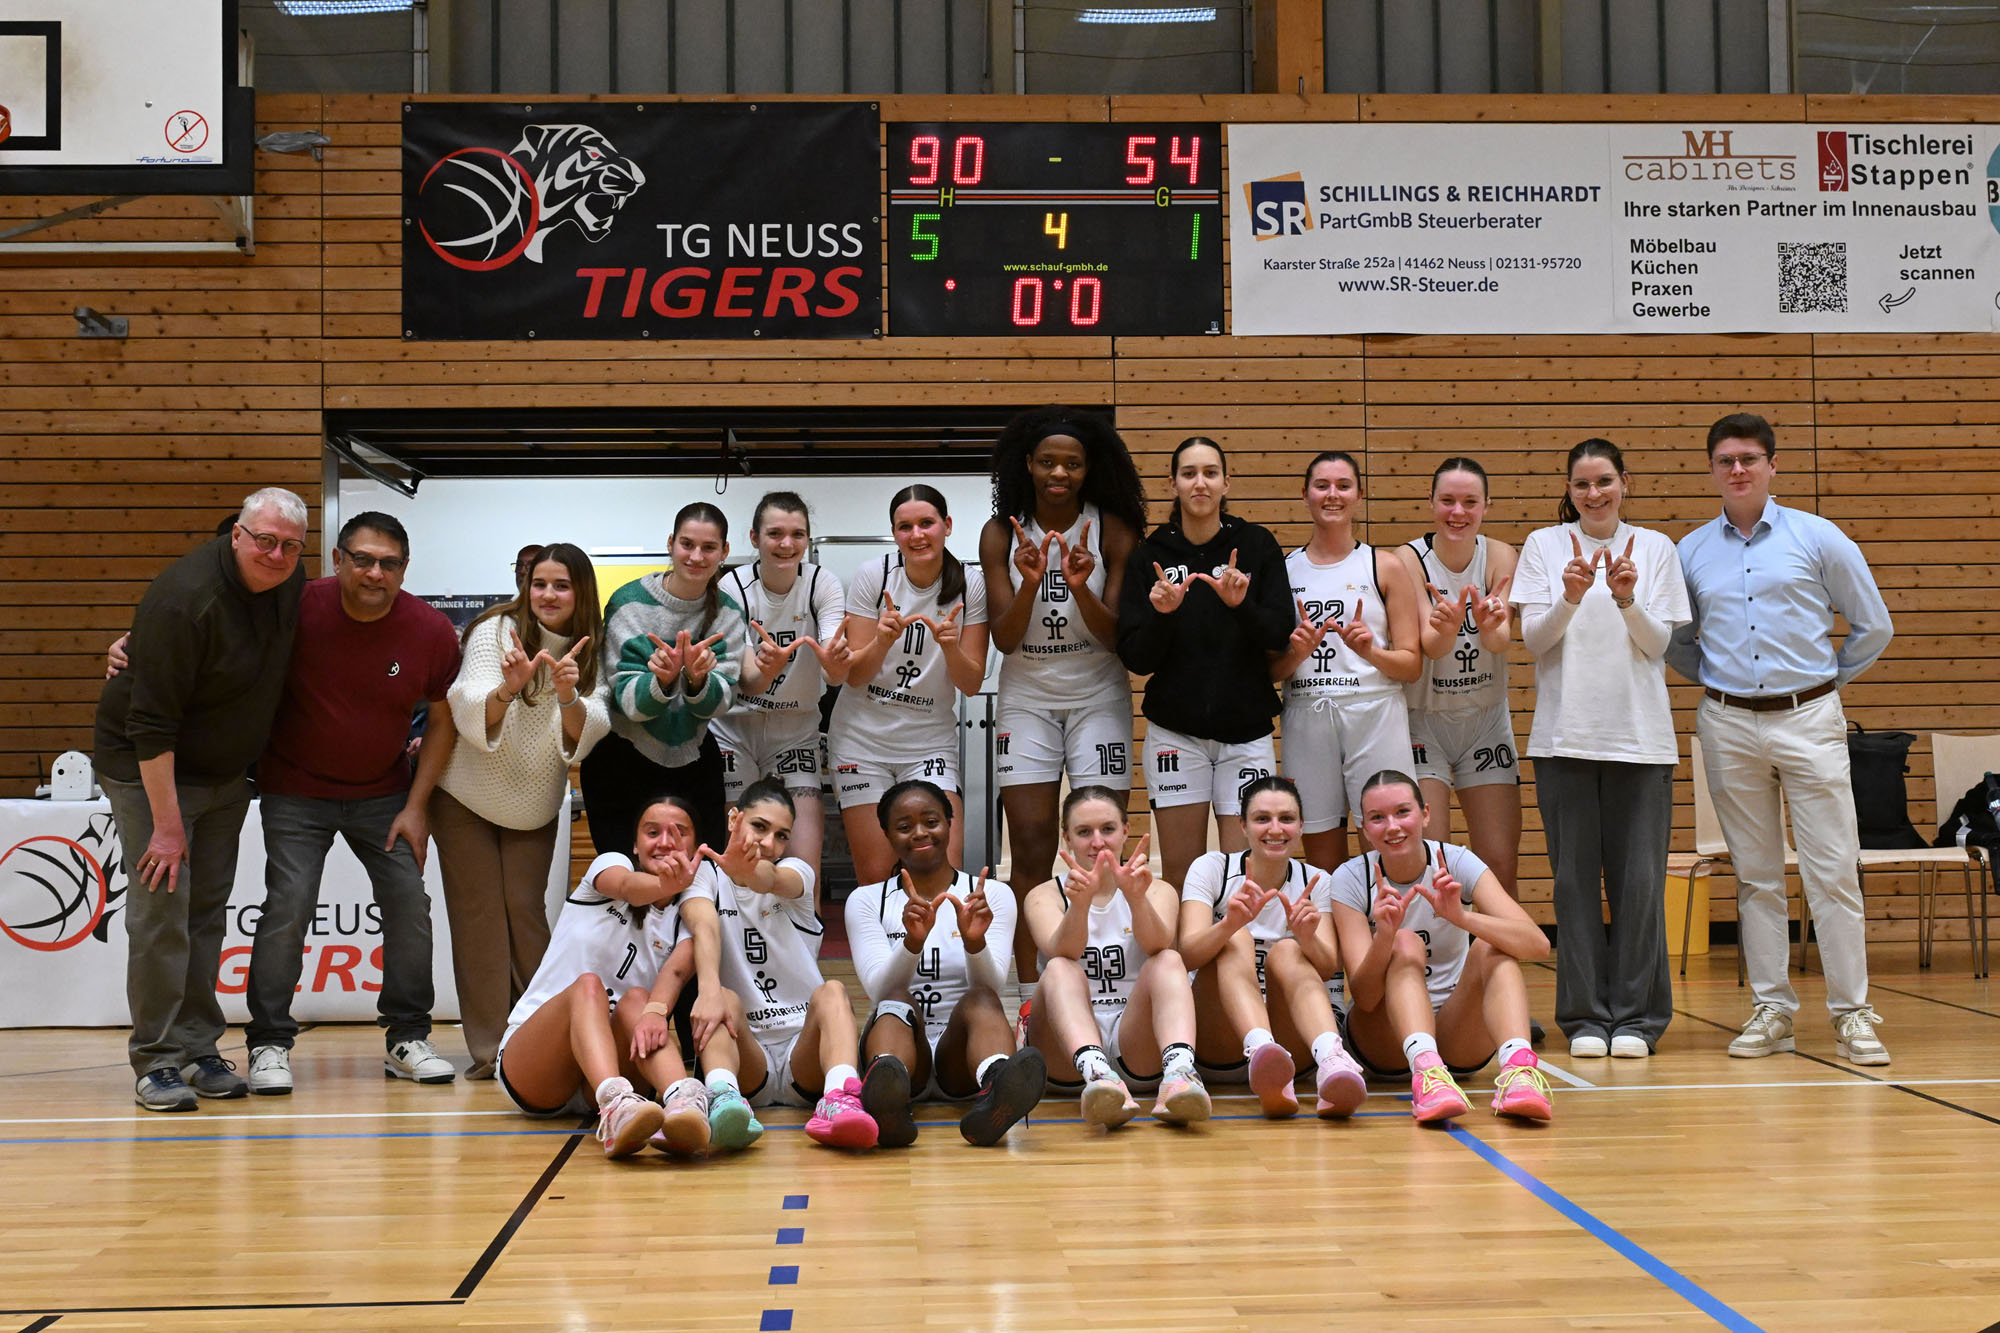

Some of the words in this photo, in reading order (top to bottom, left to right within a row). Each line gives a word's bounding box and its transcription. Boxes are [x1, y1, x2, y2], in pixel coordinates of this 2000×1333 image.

[1848, 133, 1973, 155] Tischlerei
[909, 136, 984, 184] 90
[1126, 136, 1200, 184] 54
[1624, 158, 1797, 181] cabinets
[940, 187, 954, 207] H
[1156, 187, 1169, 207] G
[1320, 186, 1439, 202] SCHILLINGS
[1446, 186, 1461, 202] &
[1468, 186, 1601, 202] REICHHARDT
[1256, 201, 1306, 235] SR
[1624, 201, 1661, 218] Ihre
[1668, 200, 1740, 218] starken
[1747, 200, 1817, 217] Partner
[1823, 201, 1846, 217] im
[1852, 200, 1976, 217] Innenausbau
[1320, 212, 1412, 229] PartGmbB
[1419, 213, 1542, 229] Steuerberater
[656, 223, 712, 258] TG
[729, 223, 863, 258] NEUSS
[911, 214, 940, 260] 5
[1045, 213, 1067, 249] 4
[1630, 238, 1717, 253] Möbelbau
[1900, 245, 1942, 260] Jetzt
[1003, 262, 1108, 273] www.schauf-gmbh.de
[1263, 258, 1316, 271] Kaarster
[1319, 257, 1360, 270] Straße
[1364, 256, 1395, 268] 252a
[1404, 258, 1444, 269] 41462
[1448, 258, 1486, 269] Neuss
[1496, 257, 1582, 270] 02131-95720
[1631, 260, 1698, 275] Küchen
[1338, 276, 1499, 293] www.SR-Steuer.de
[1900, 268, 1975, 281] scannen
[576, 267, 863, 318] TIGERS
[1632, 282, 1693, 296] Praxen
[1633, 302, 1711, 317] Gewerbe
[1041, 570, 1068, 602] 15
[1304, 600, 1344, 632] 22
[868, 684, 934, 706] NEUSSERREHA
[776, 749, 816, 774] 25
[1096, 742, 1126, 775] 15
[1157, 754, 1179, 773] fit
[841, 782, 869, 792] Kempa
[1158, 783, 1187, 792] Kempa
[744, 928, 767, 964] 5
[616, 942, 637, 980] 1
[917, 947, 940, 980] 4
[1080, 945, 1126, 980] 33
